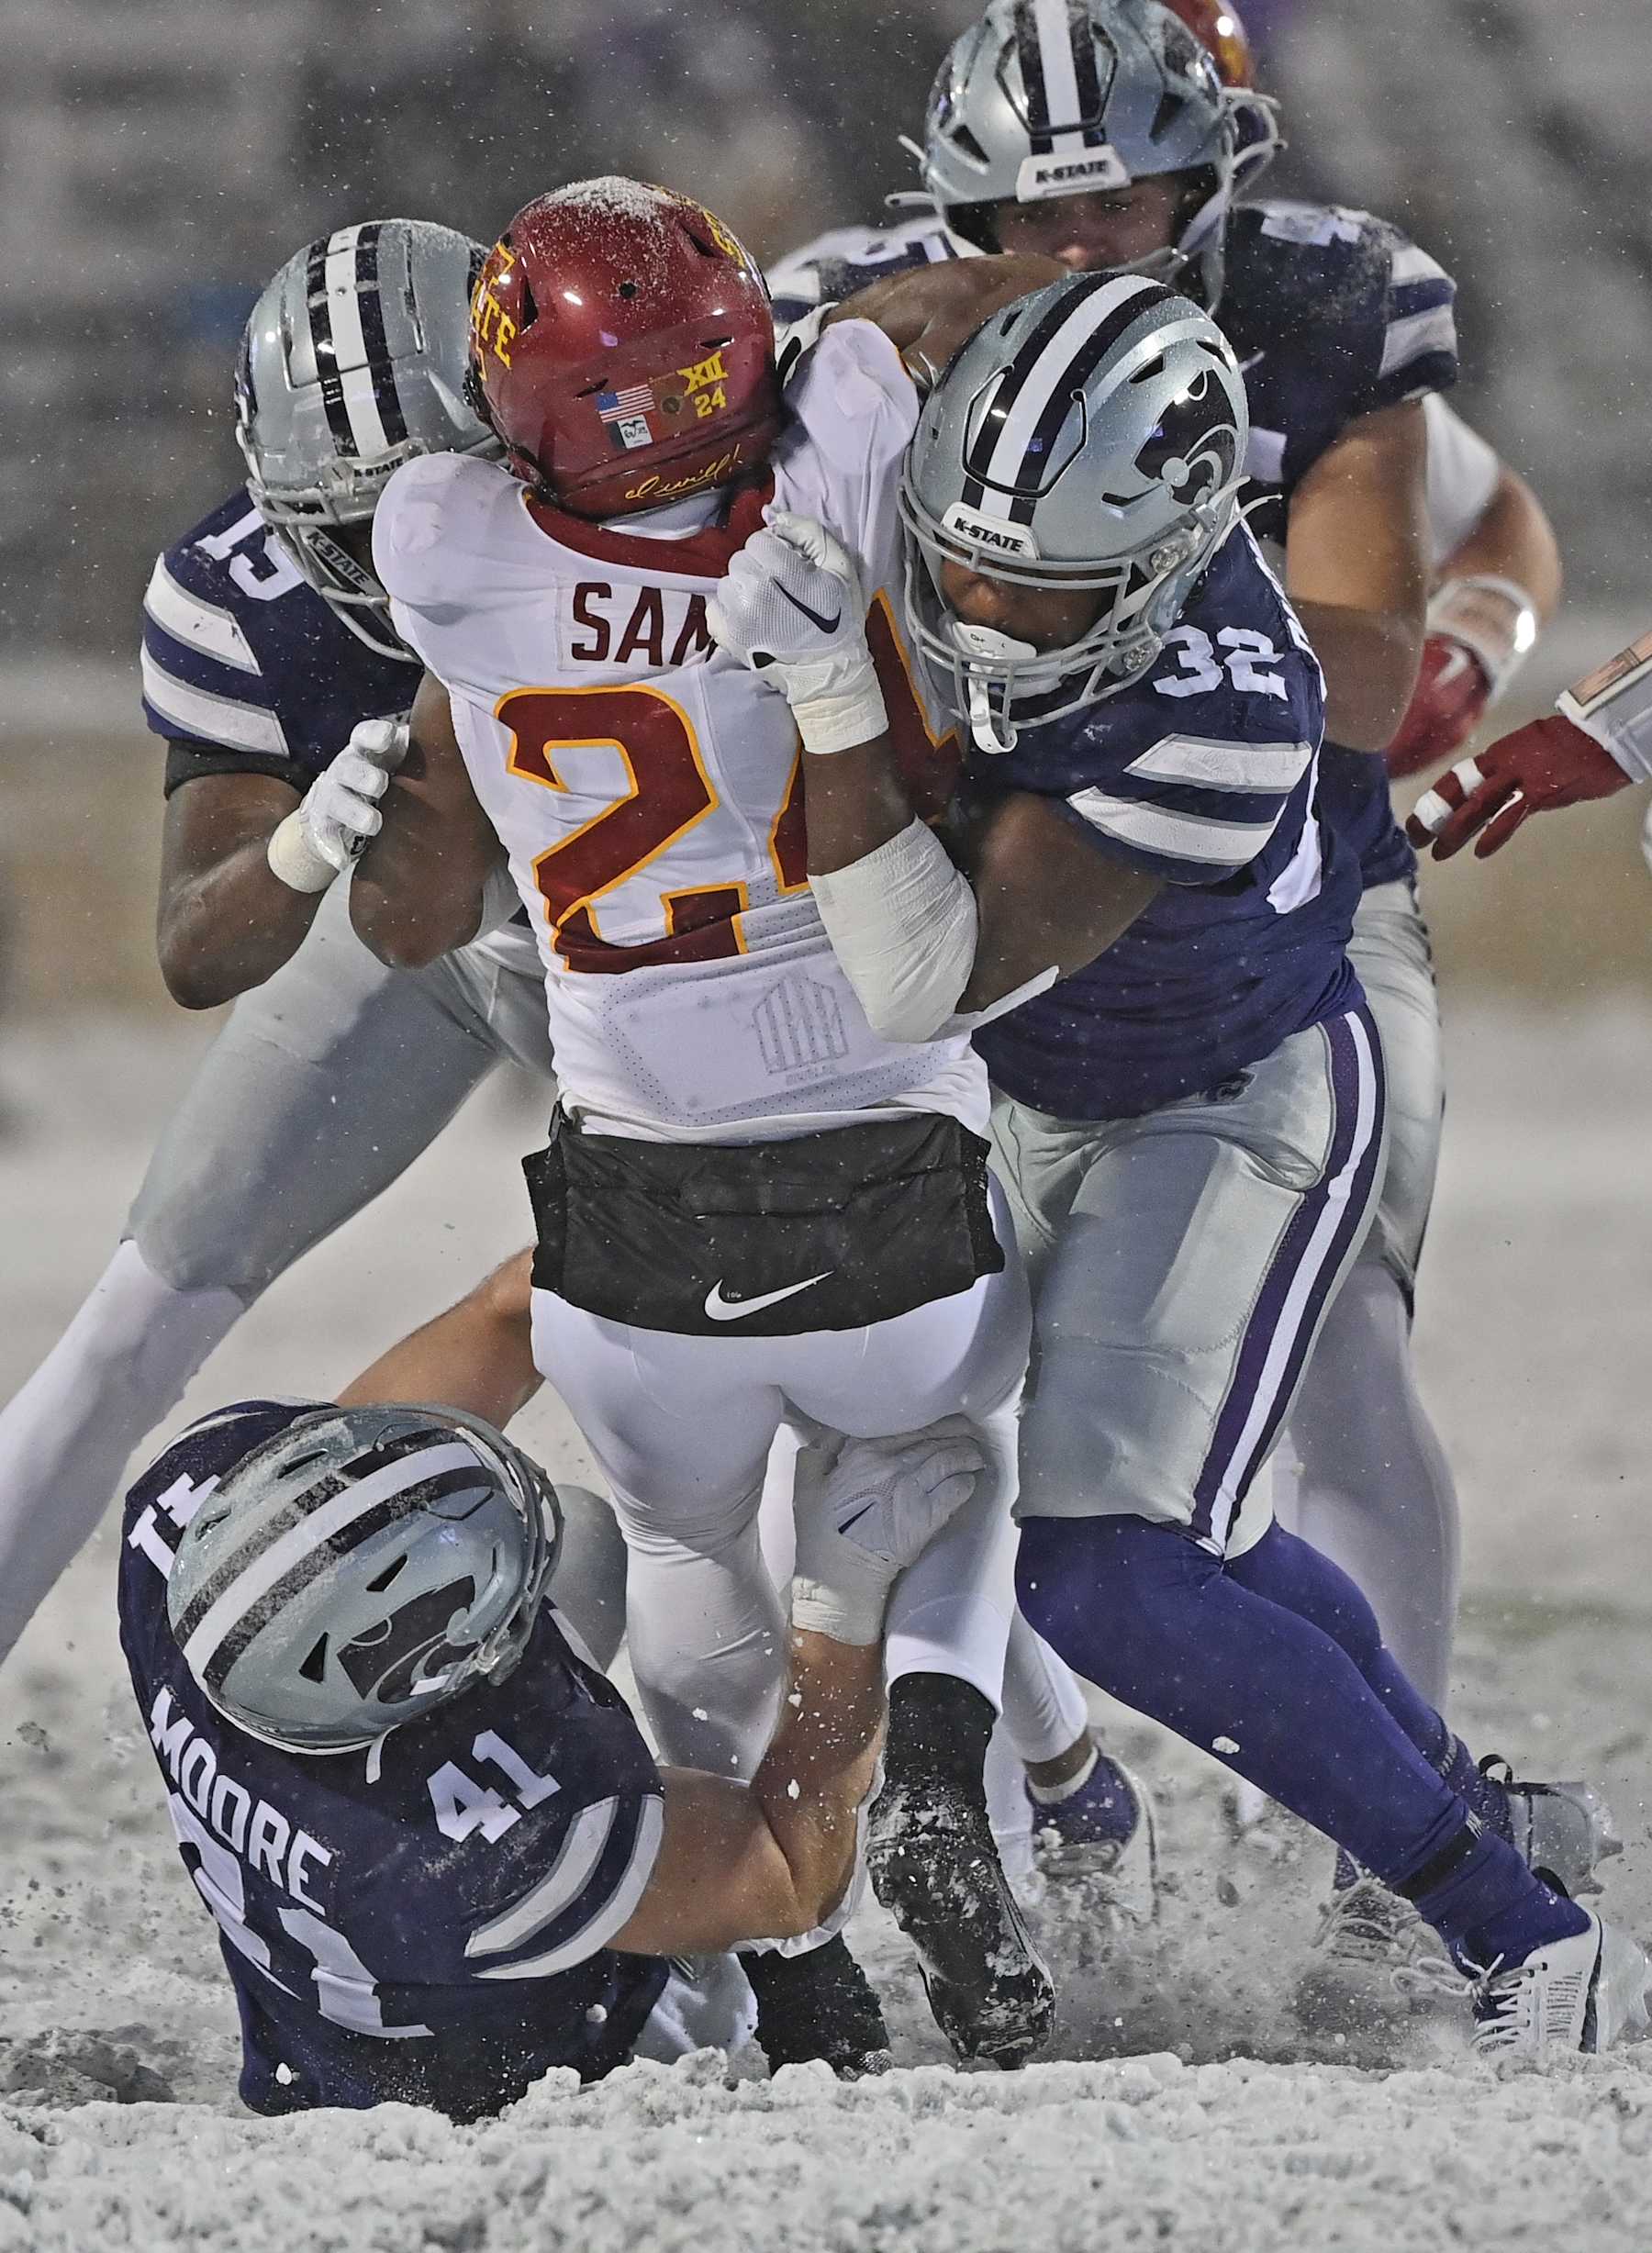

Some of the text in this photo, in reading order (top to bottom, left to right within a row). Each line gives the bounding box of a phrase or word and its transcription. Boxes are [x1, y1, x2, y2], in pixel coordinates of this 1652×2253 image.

[1035, 160, 1109, 183] K-STATE
[676, 351, 729, 397] XII
[694, 385, 727, 418] 24
[353, 457, 405, 478] K-STATE
[954, 517, 1024, 552] K-STATE
[307, 531, 368, 586] K-STATE
[1153, 624, 1289, 702] 32
[150, 1686, 333, 1917] MOORE
[426, 1729, 563, 1845] 41
